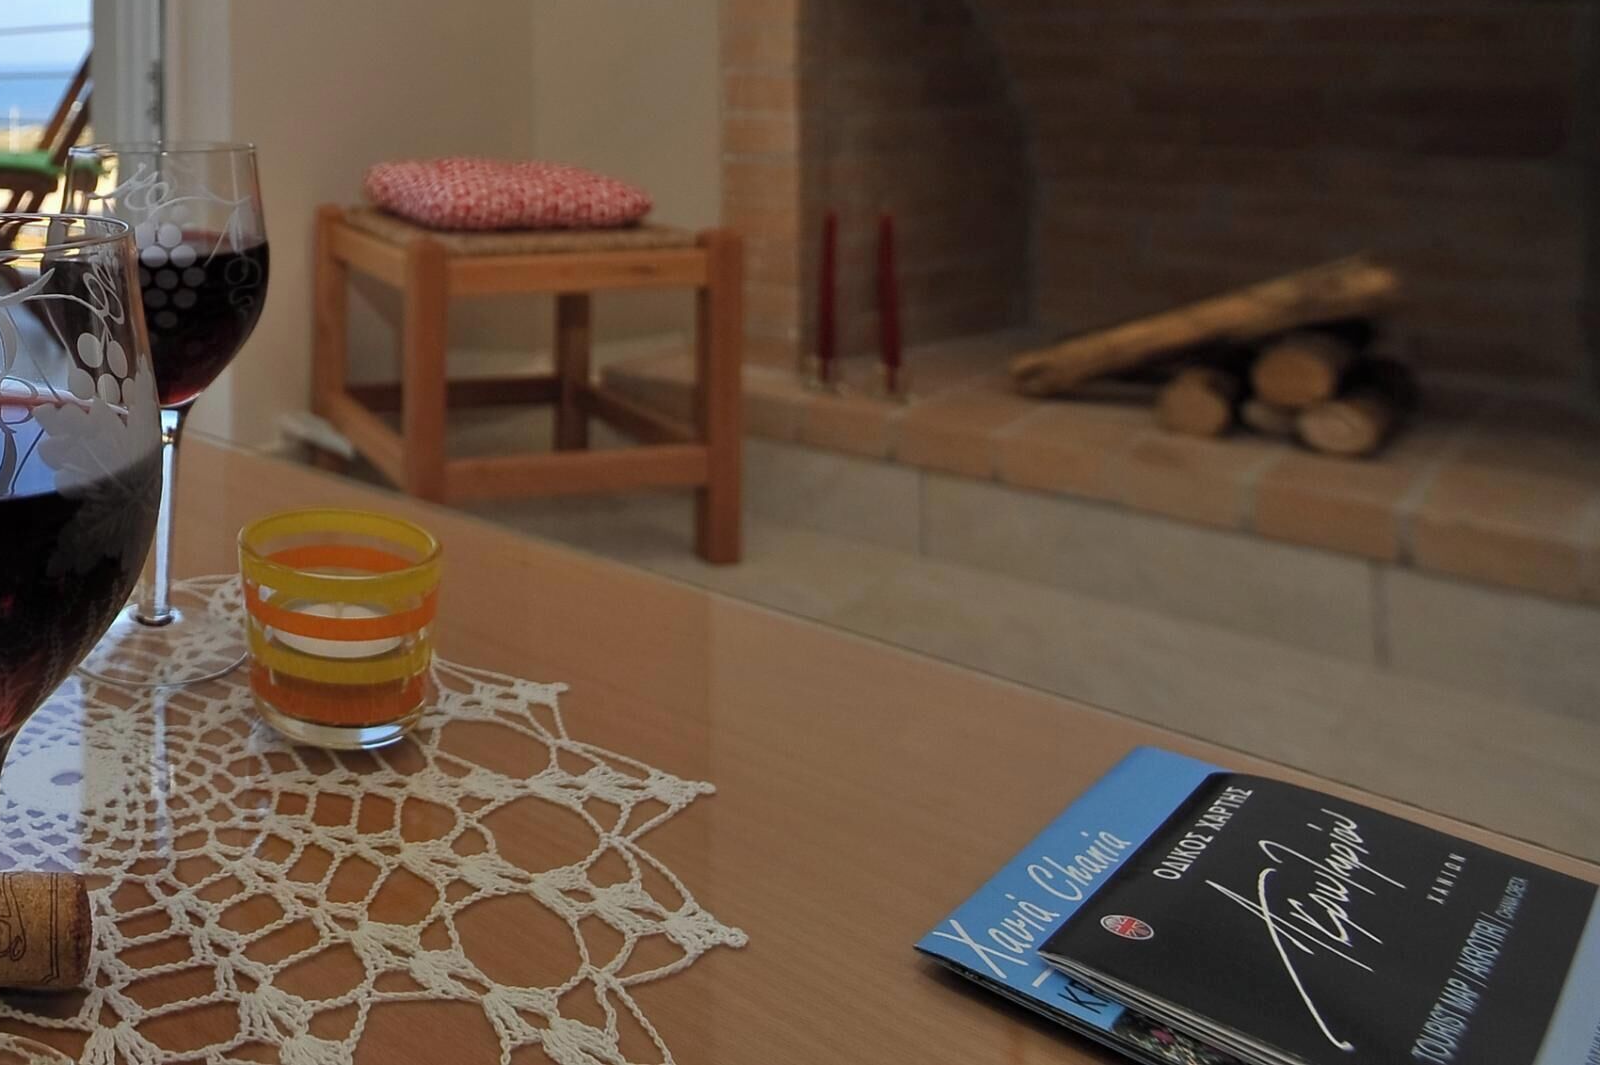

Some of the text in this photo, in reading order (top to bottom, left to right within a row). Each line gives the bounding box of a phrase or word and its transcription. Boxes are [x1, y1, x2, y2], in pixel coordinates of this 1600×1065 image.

[1153, 786, 1253, 880] ΟΔΙΚΟΣ ΧΑΡΤΗΣ
[1426, 852, 1467, 905] ΧΑΝΙΩΝ
[1456, 918, 1509, 981] AKROTIRI
[1438, 977, 1480, 1014] MAP
[1411, 1002, 1468, 1065] TOURIST
